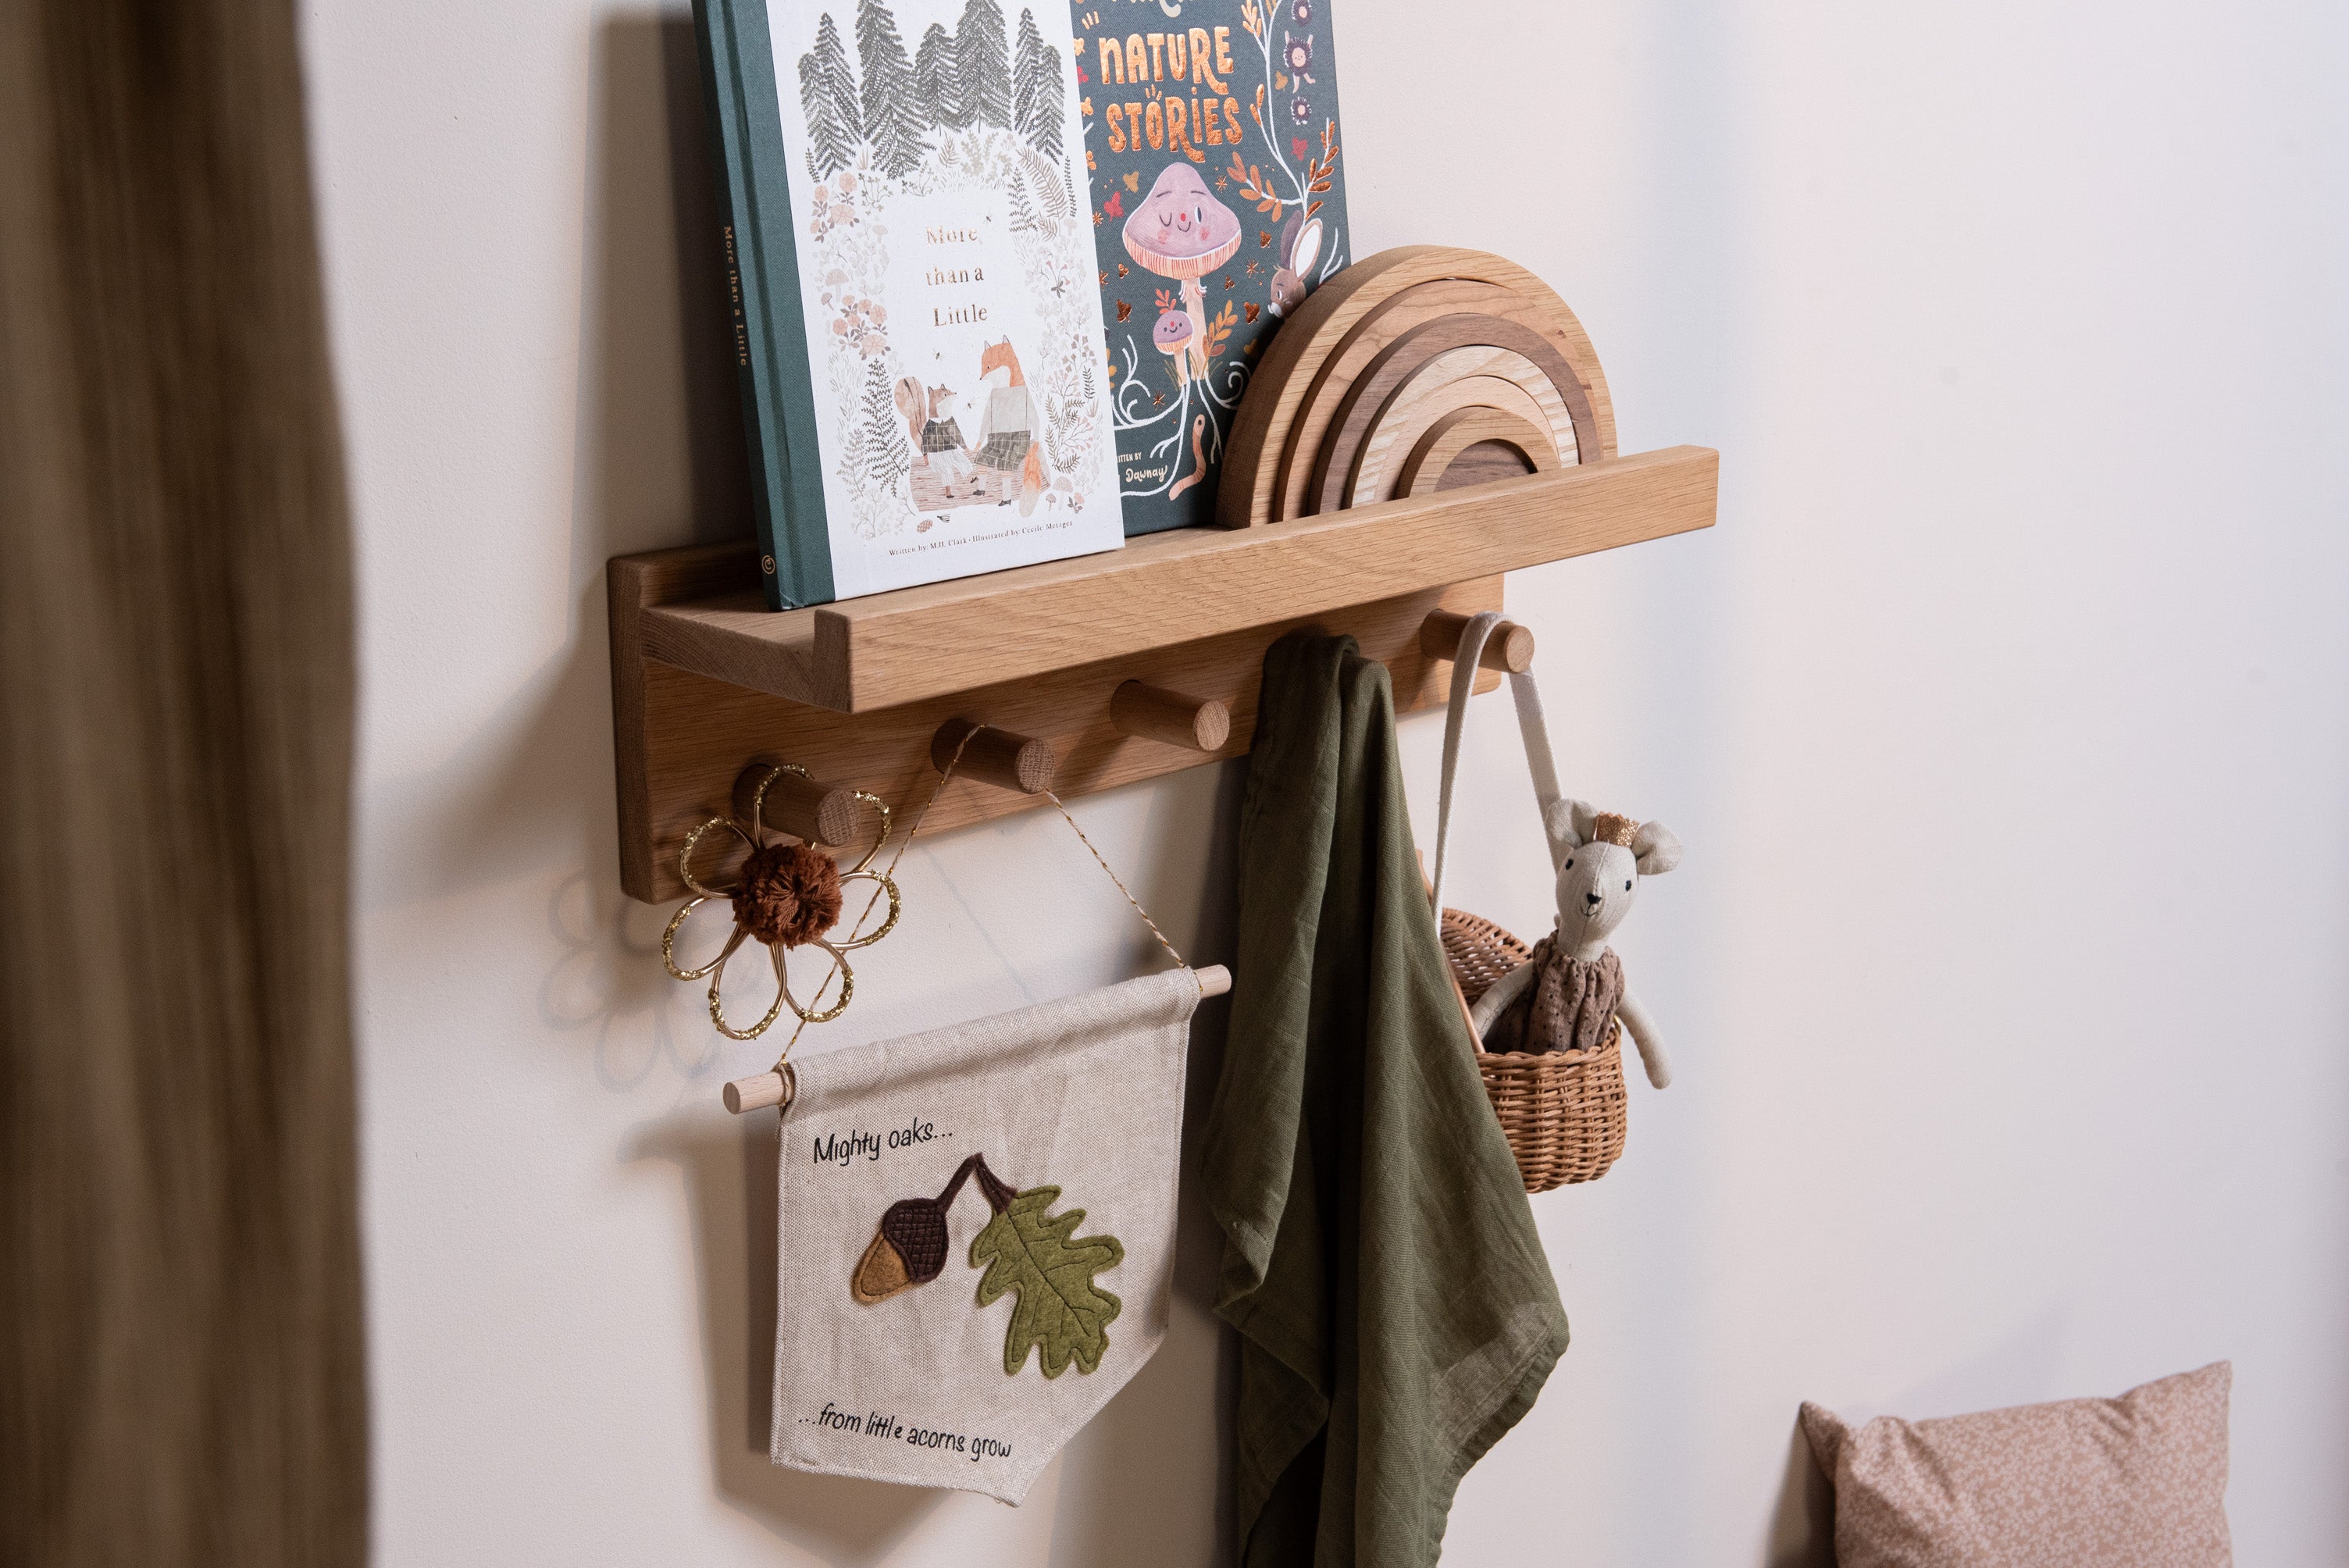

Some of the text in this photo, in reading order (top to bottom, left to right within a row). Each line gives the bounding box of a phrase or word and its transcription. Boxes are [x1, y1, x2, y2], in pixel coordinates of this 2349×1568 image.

[1099, 27, 1234, 94] NATURE
[925, 226, 978, 245] More
[925, 266, 984, 286] than a
[724, 226, 734, 264] More
[729, 270, 739, 302] than
[736, 324, 747, 365] Little
[933, 304, 988, 326] Little
[1117, 452, 1142, 463] ITTEN BY
[1125, 465, 1168, 483] Dawnay
[889, 547, 916, 556] Written
[972, 530, 1009, 543] Illustrated
[1046, 521, 1073, 530] Metzger
[814, 1117, 953, 1167] Mighty oaks...
[864, 1411, 903, 1439] little
[907, 1427, 965, 1452] acorns
[971, 1437, 1011, 1462] grow
